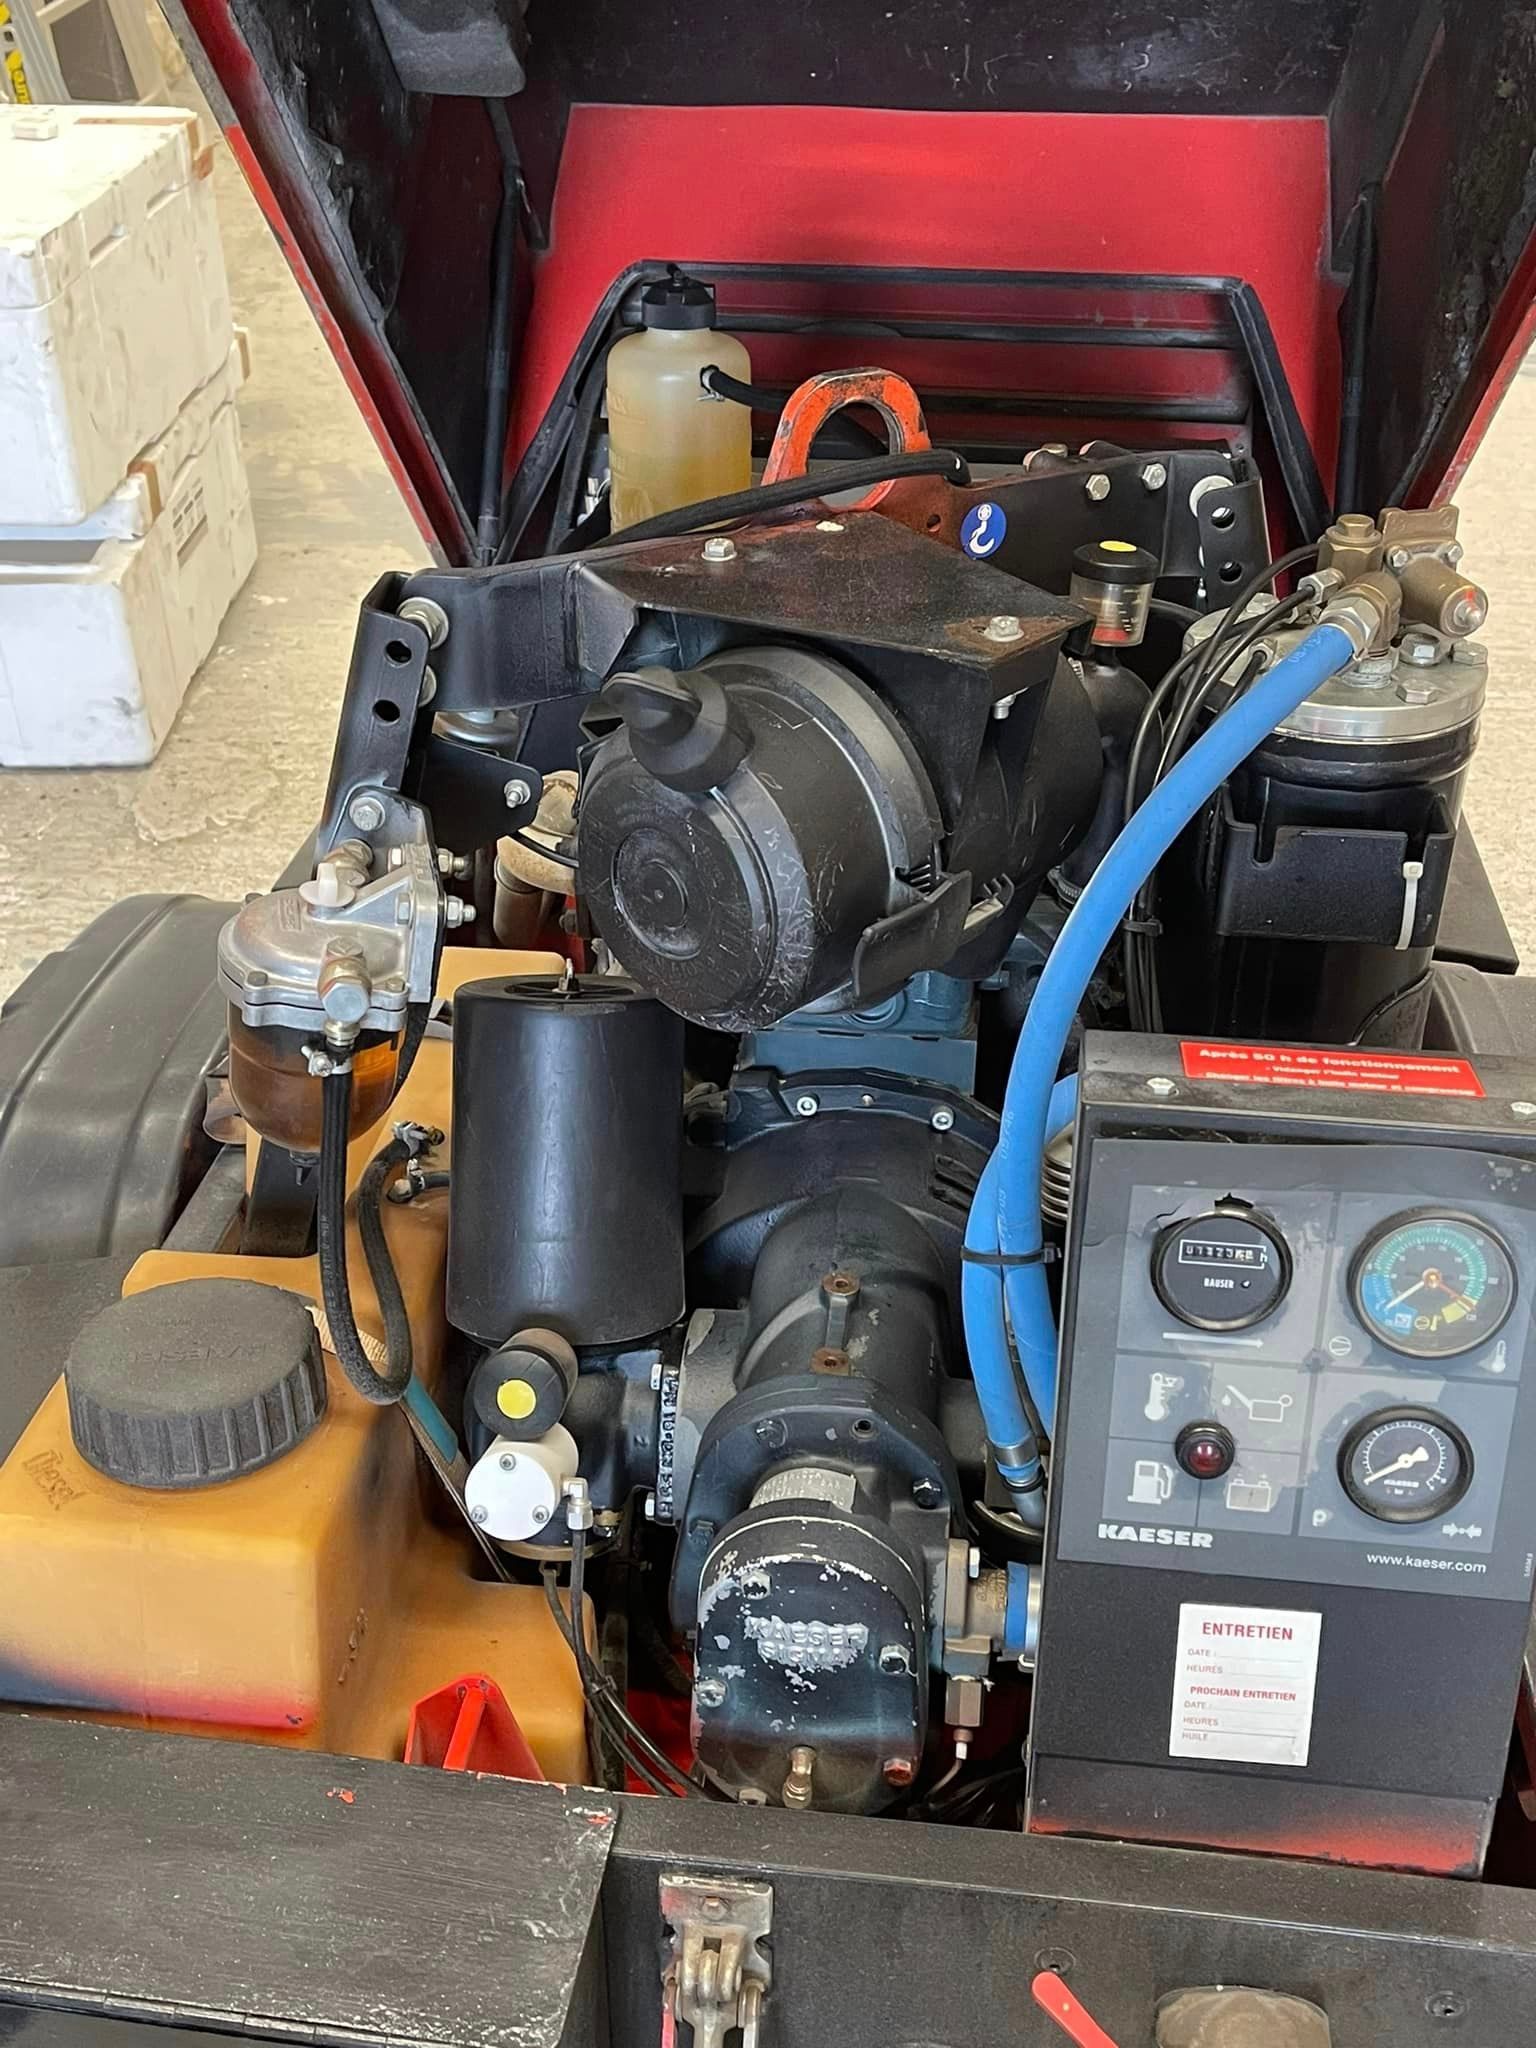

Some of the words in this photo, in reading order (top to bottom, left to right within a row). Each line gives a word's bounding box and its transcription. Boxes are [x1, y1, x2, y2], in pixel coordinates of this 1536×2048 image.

[1199, 1048, 1249, 1060] Après
[1252, 1052, 1275, 1062] 50
[1279, 1054, 1292, 1063] h
[1296, 1056, 1318, 1065] de
[1322, 1057, 1461, 1073] fonctionnement
[1098, 1523, 1214, 1548] KAESER
[1366, 1553, 1487, 1574] www.kaeser.com
[1202, 1621, 1294, 1641] ENTRETIEN
[1188, 1648, 1211, 1658] DATE
[1186, 1664, 1223, 1674] HEURES
[1190, 1686, 1241, 1698] PROCHAIN
[1242, 1689, 1297, 1702] ENTRETIEN
[1184, 1700, 1206, 1710] DATE
[1183, 1716, 1219, 1727] HEURES
[1182, 1732, 1208, 1742] HUILE
